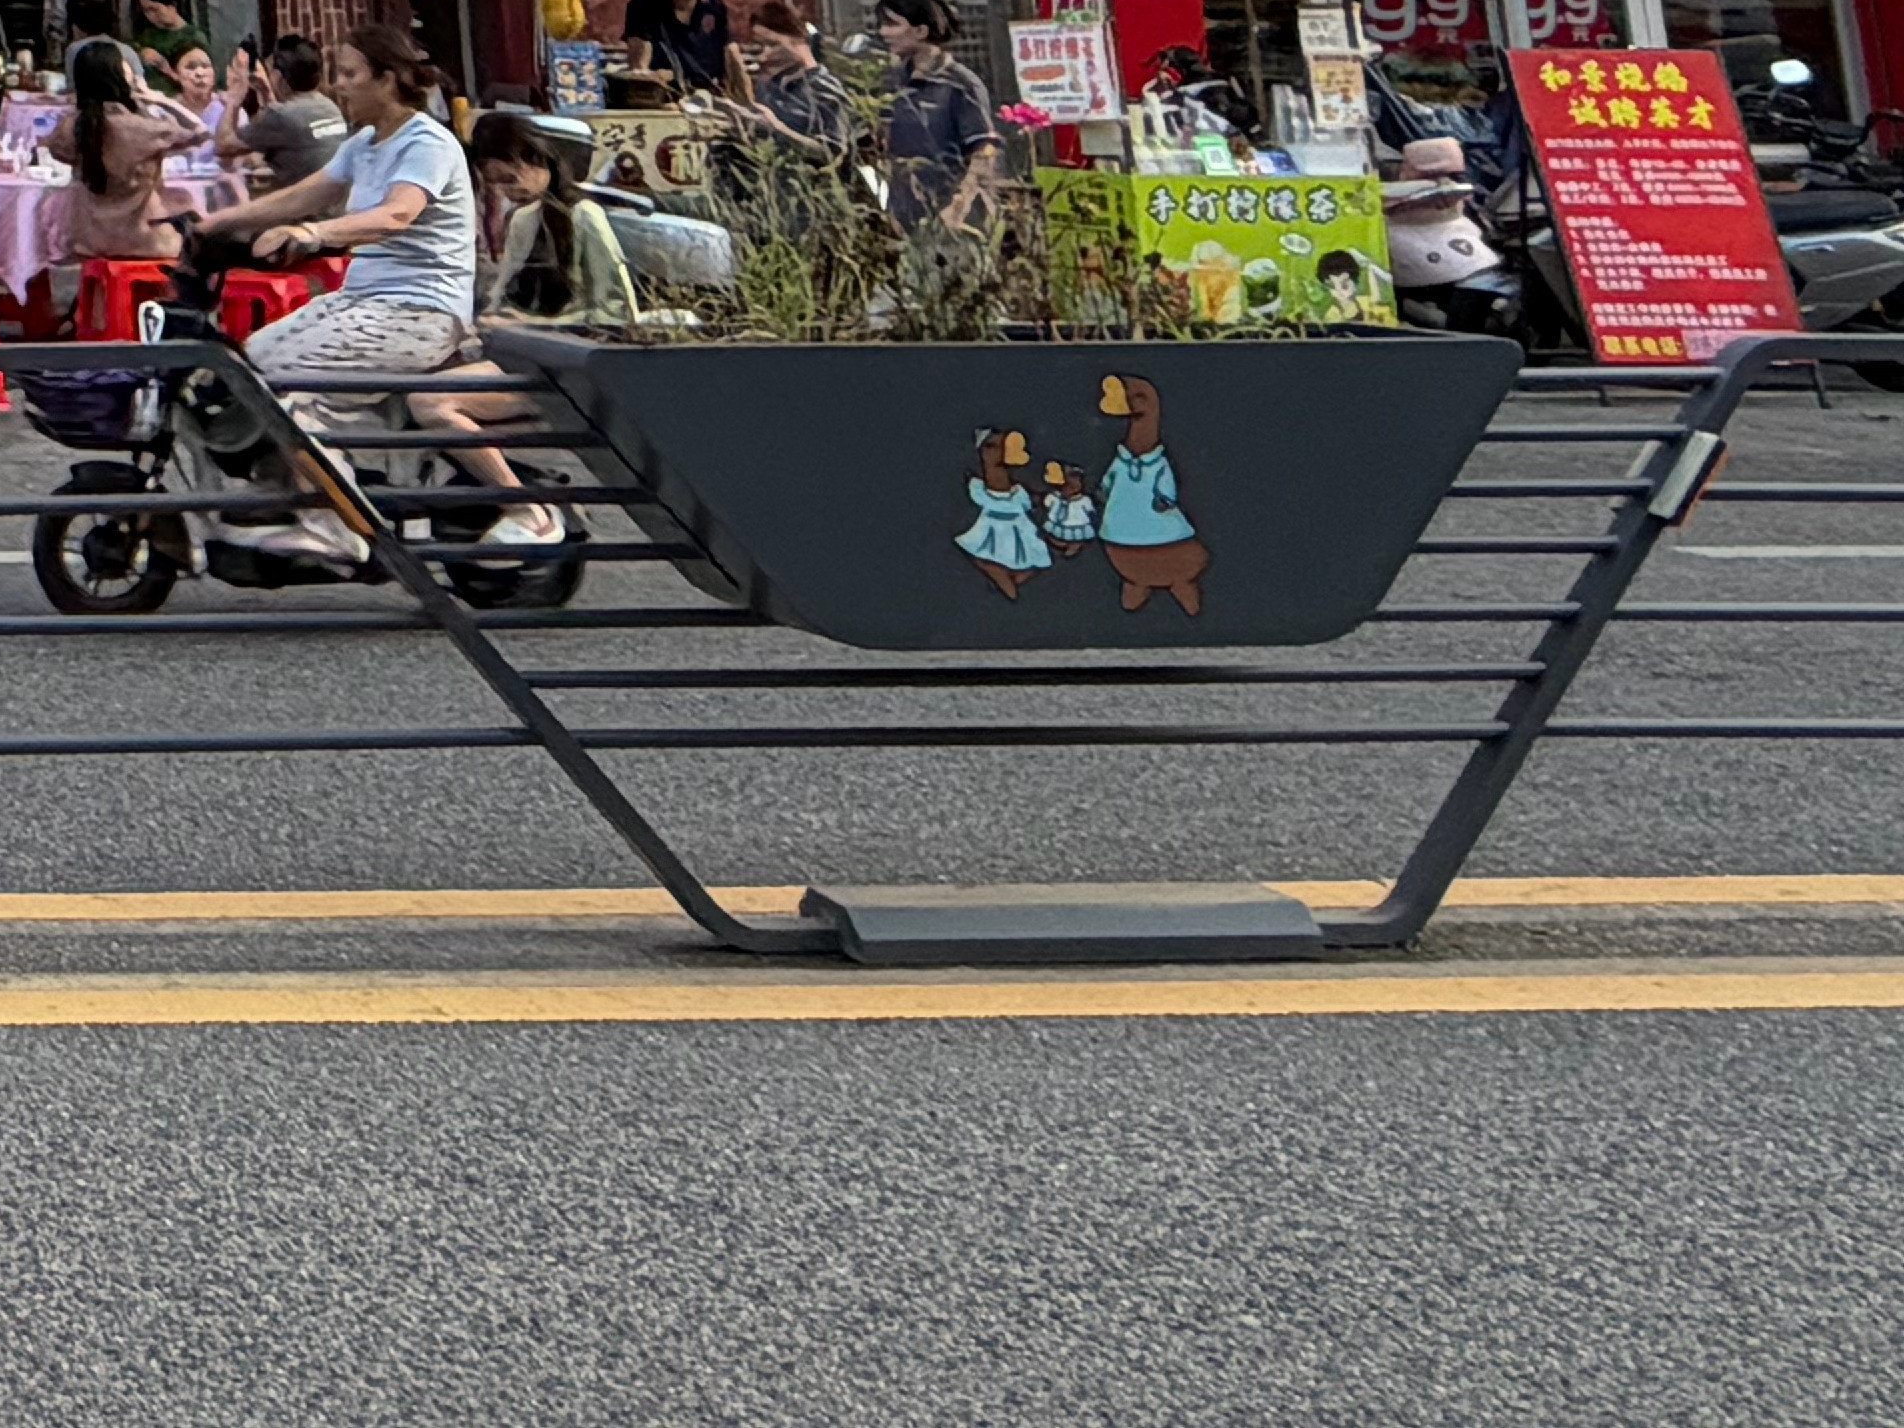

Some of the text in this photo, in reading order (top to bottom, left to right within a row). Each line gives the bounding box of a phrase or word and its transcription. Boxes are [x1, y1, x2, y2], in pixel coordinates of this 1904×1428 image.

[1539, 59, 1690, 94] 和景烧鹅
[1147, 184, 1340, 225] 手打柠檬茶
